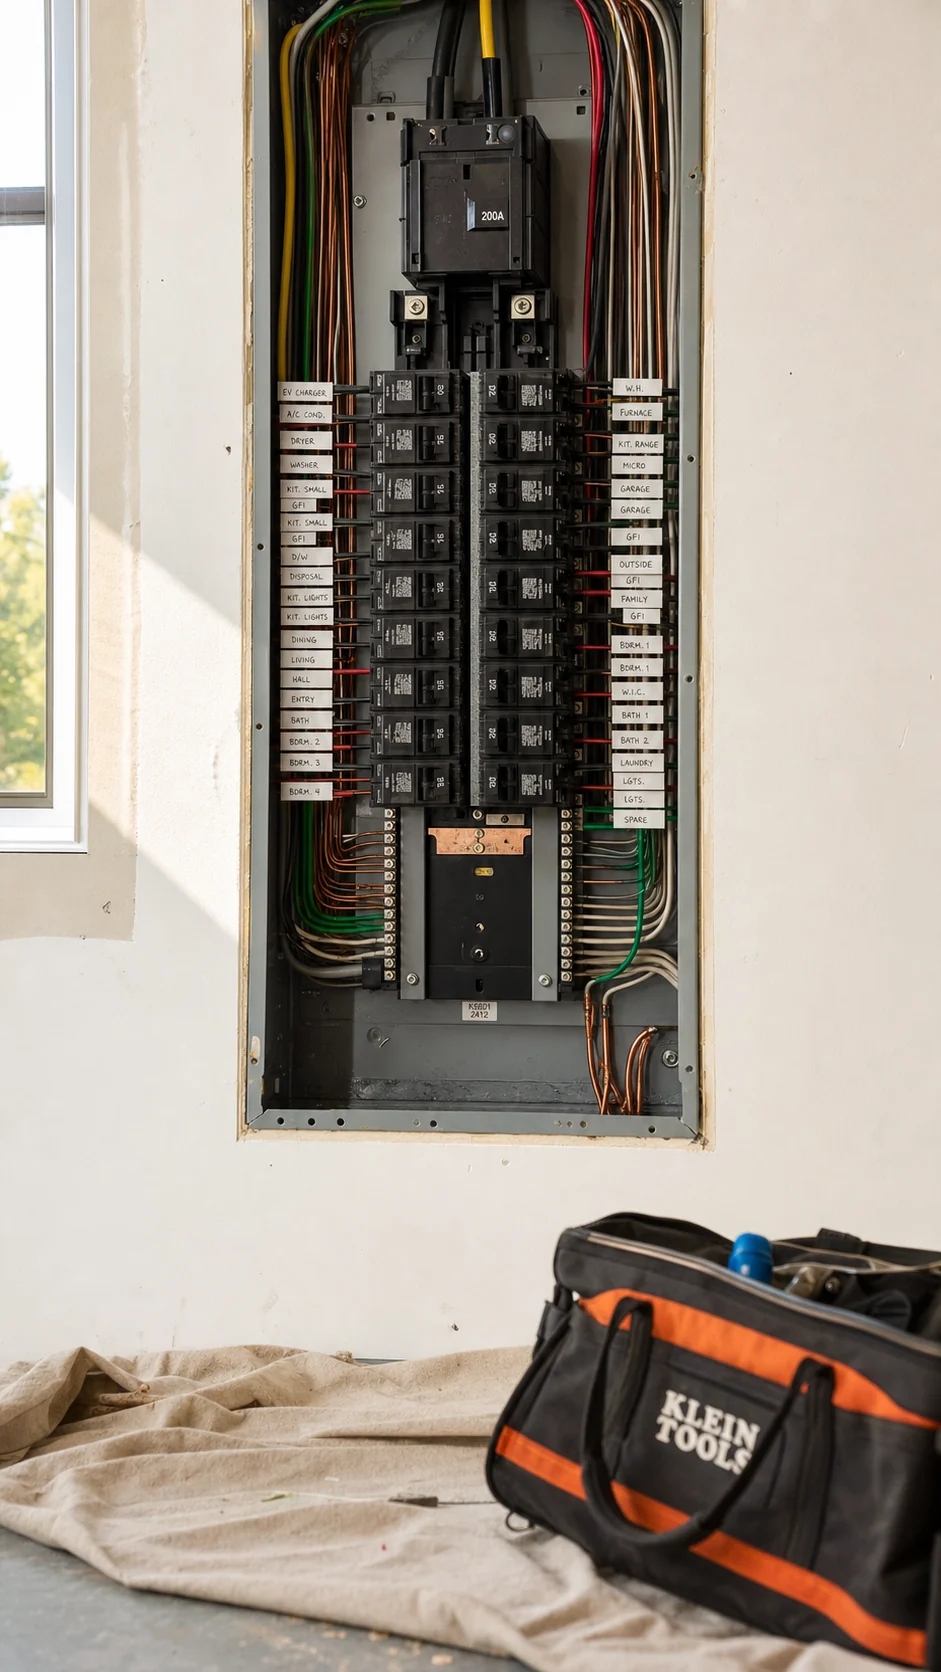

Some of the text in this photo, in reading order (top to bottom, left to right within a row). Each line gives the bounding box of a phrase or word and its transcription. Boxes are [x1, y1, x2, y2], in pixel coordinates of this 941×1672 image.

[482, 210, 504, 220] 200A
[626, 384, 644, 392] W.H.
[282, 388, 327, 397] EV CHARGER
[286, 410, 300, 418] A/C
[620, 408, 652, 416] FURNACE
[290, 437, 316, 445] DRYER
[292, 501, 306, 509] GFI
[626, 533, 640, 541] GFI
[292, 554, 308, 562] D/W
[619, 560, 652, 568] OUTSIDE
[290, 572, 324, 580] DISPOSAL
[626, 576, 640, 584] GFI
[621, 596, 648, 604] FAMILY
[630, 612, 644, 620] GFI
[292, 696, 315, 704] ENTRY
[620, 736, 640, 744] BATH
[624, 796, 645, 804] LGTS.
[660, 1389, 760, 1452] KLEIN
[655, 1414, 752, 1475] TOOLS
